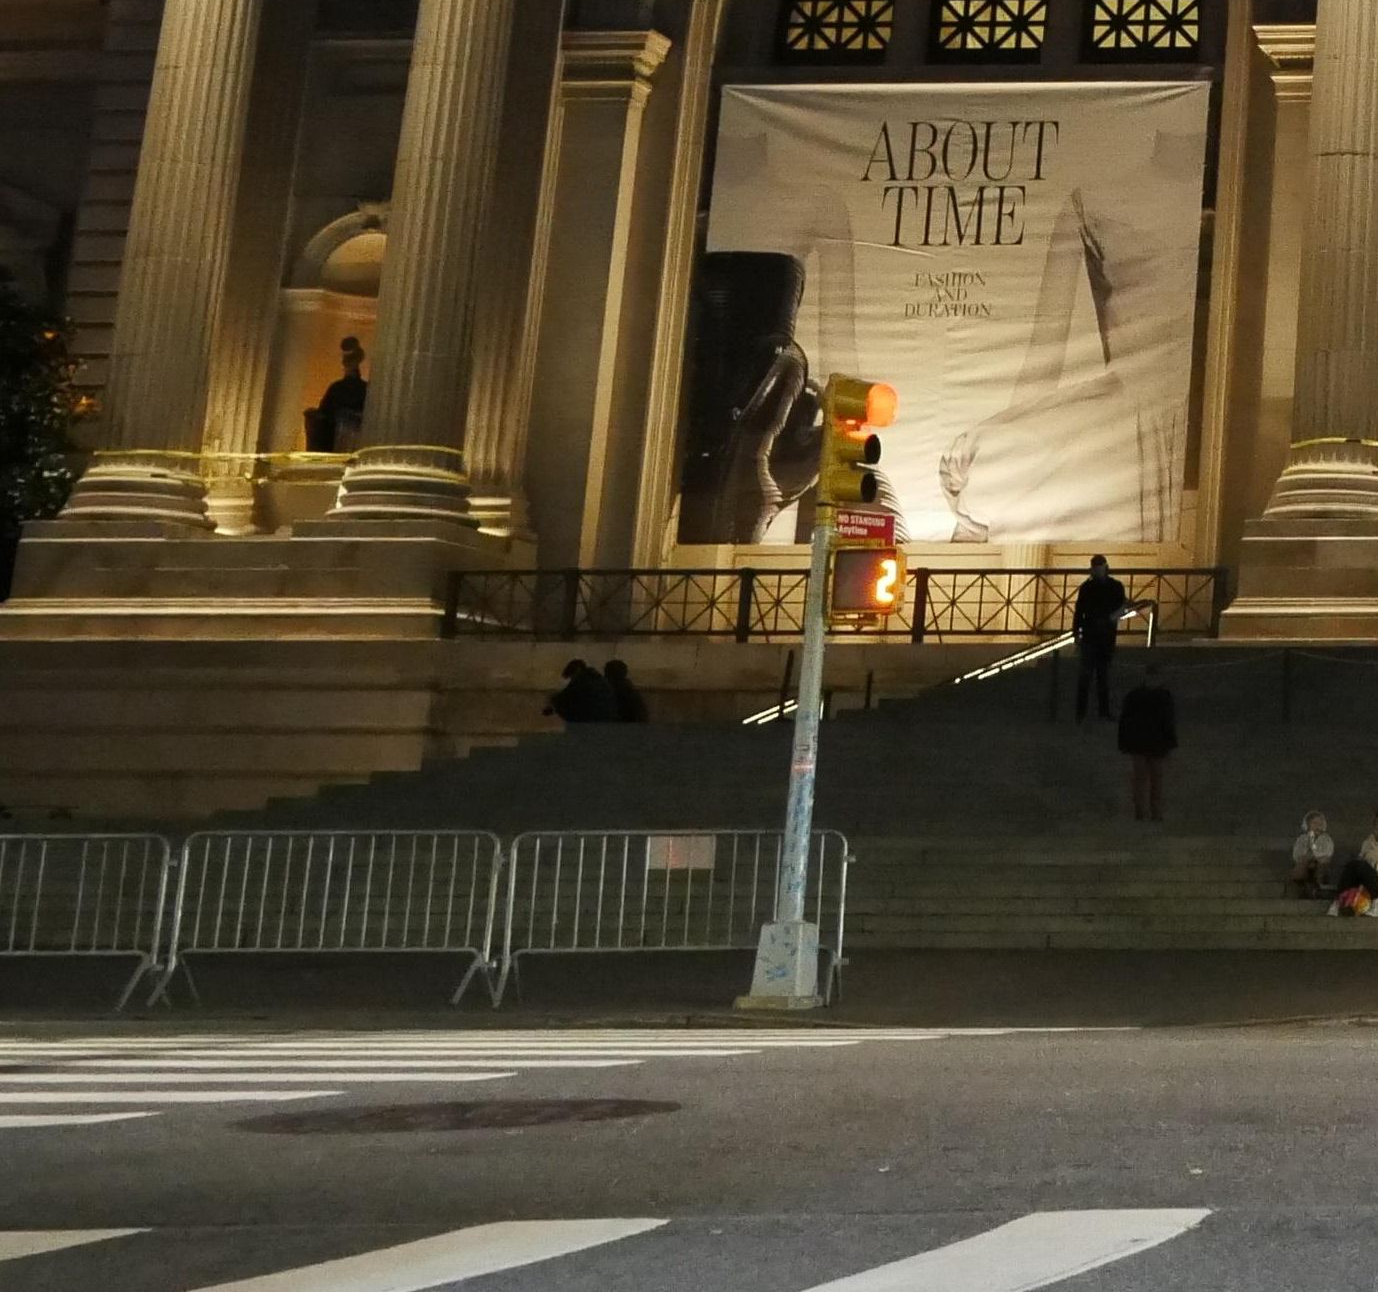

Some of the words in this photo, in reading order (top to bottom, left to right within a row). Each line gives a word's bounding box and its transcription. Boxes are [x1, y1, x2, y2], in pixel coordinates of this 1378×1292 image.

[860, 120, 1060, 182] ABOUT
[881, 185, 1026, 246] TIME
[914, 271, 987, 288] FASHION
[935, 287, 969, 302] AND
[904, 302, 993, 318] DURATION
[838, 514, 850, 524] NO
[850, 515, 886, 528] STANDING
